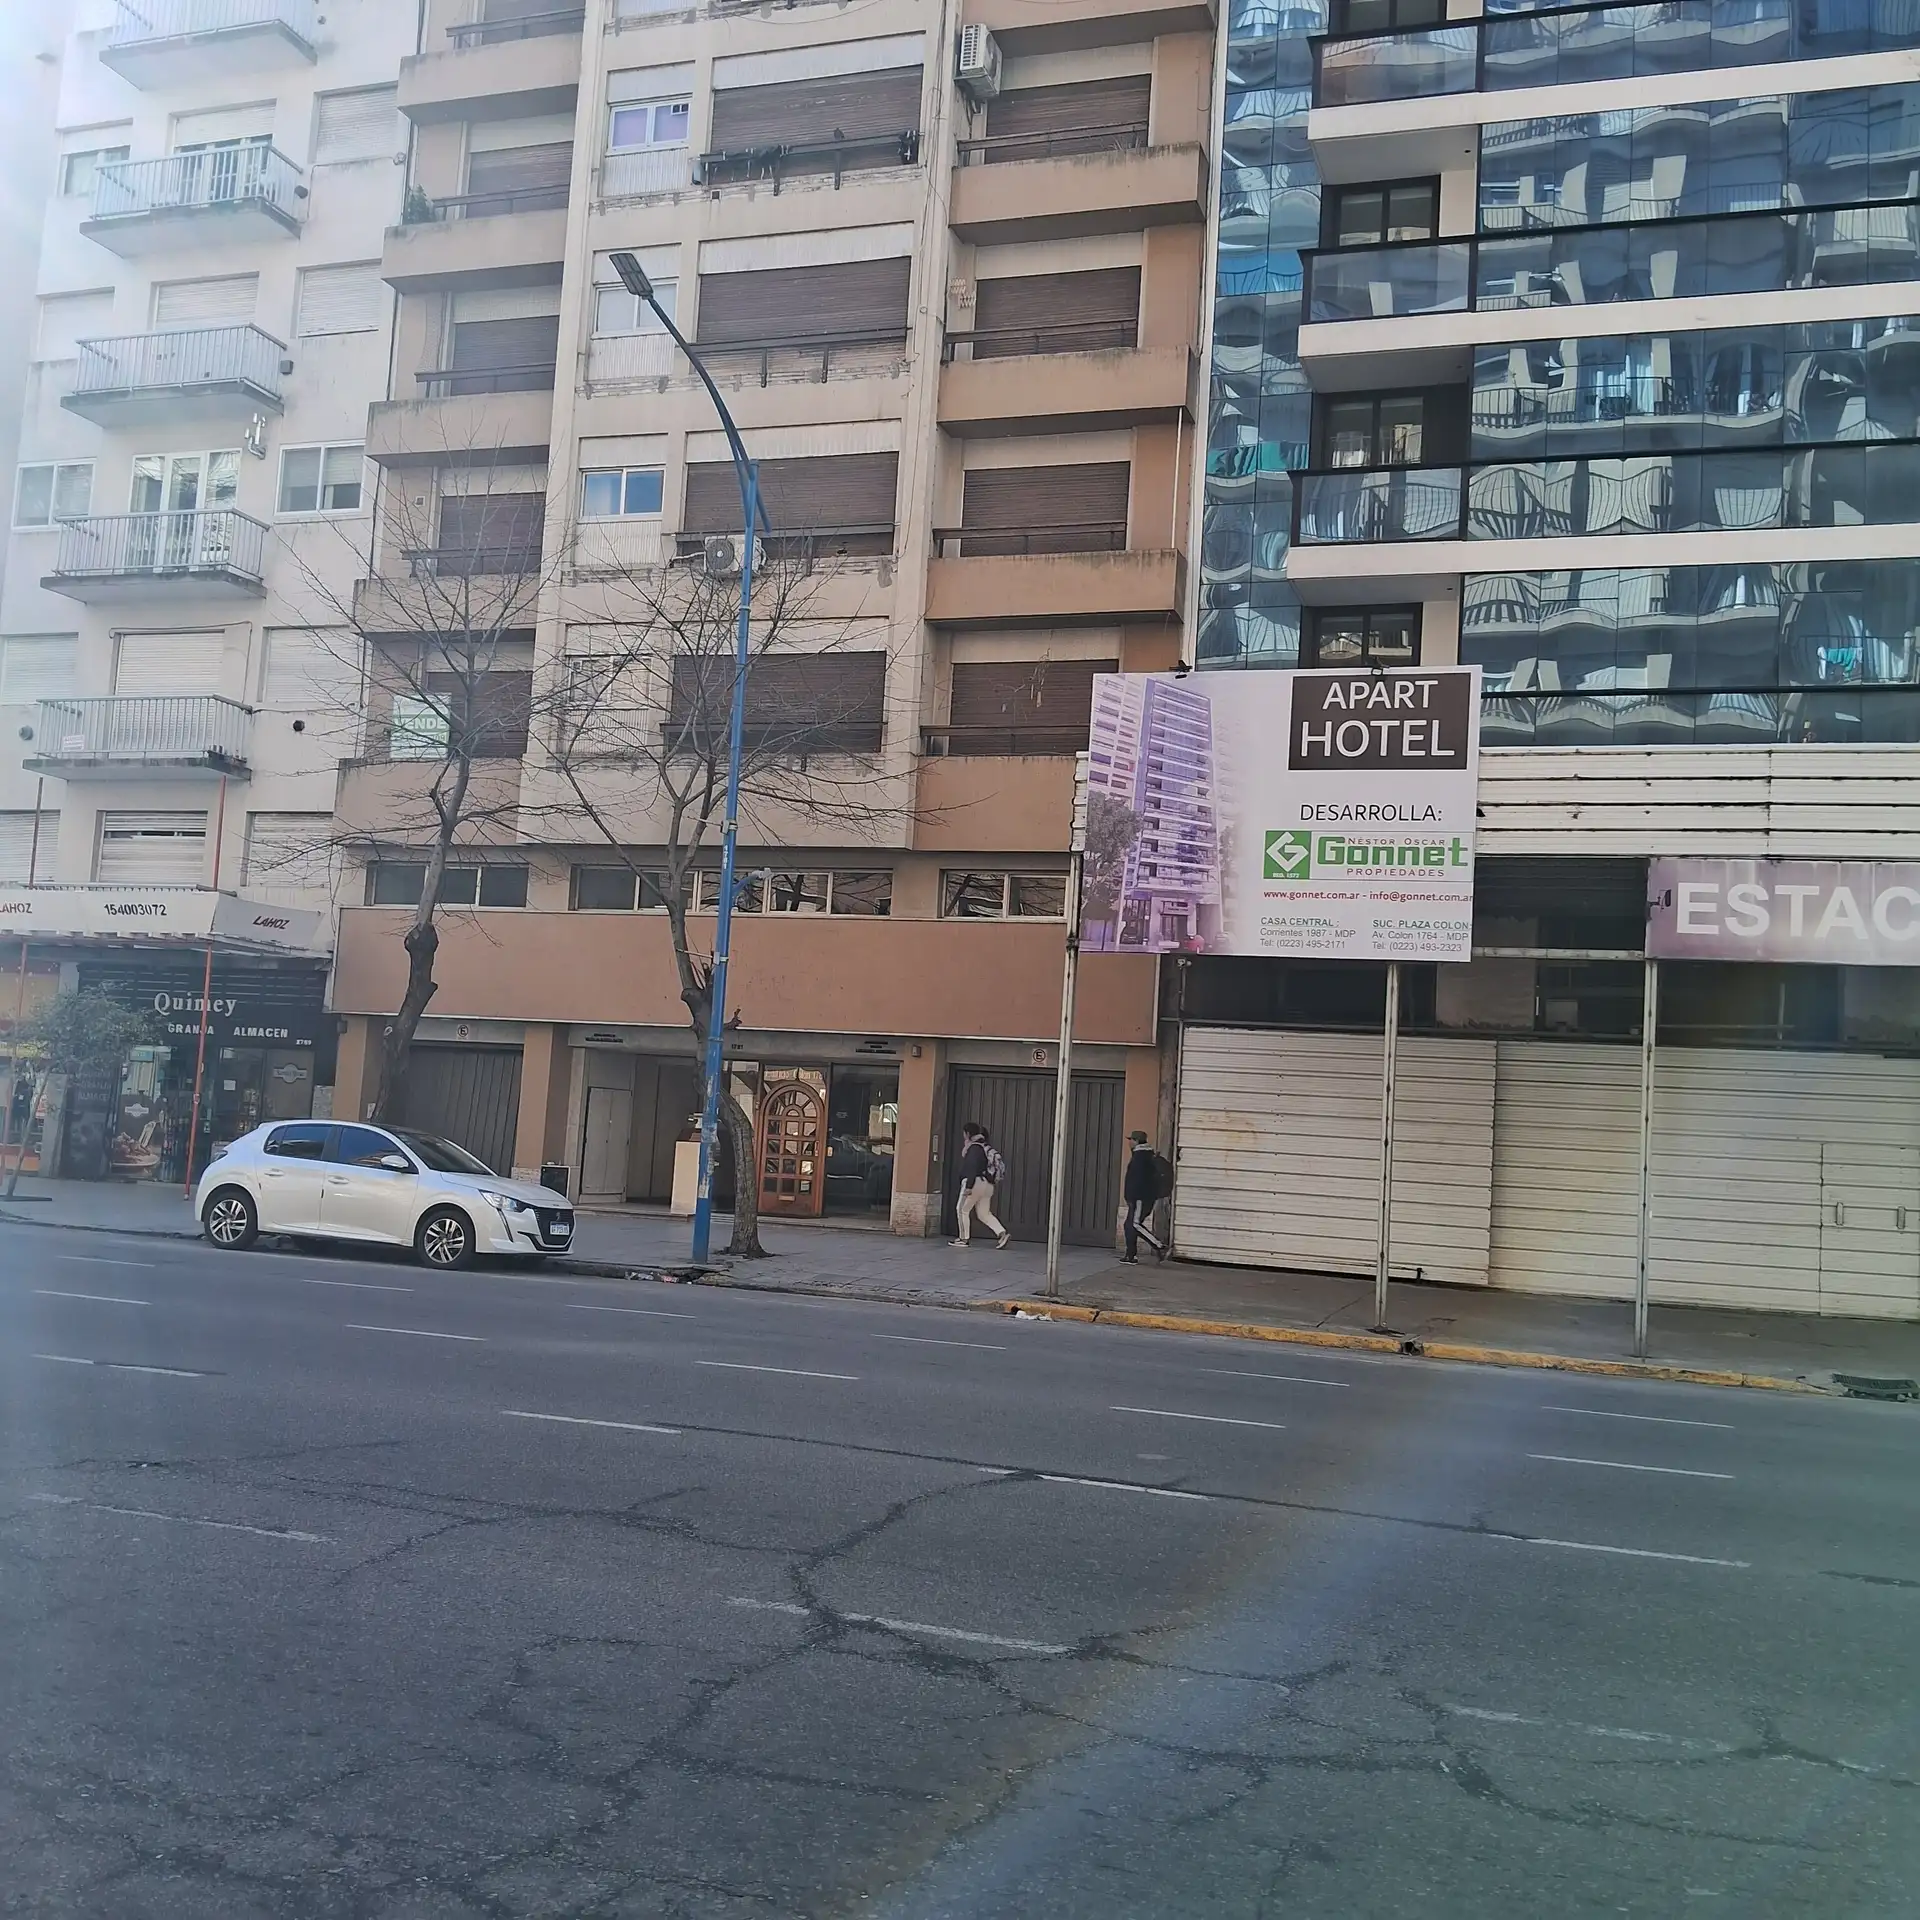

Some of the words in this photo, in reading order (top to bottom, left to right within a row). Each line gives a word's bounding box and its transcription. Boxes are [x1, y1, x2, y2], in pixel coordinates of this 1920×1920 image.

[1322, 680, 1439, 710] APART
[1300, 719, 1456, 758] HOTEL
[1300, 803, 1444, 822] DESARROLLA:
[1404, 837, 1446, 847] OSCAR
[1317, 836, 1469, 867] Gonnet
[1346, 868, 1445, 877] PROPIEDADES
[1263, 890, 1360, 901] www.gonnet.com.ar
[104, 903, 168, 916] 154003072
[1676, 881, 1920, 941] ESTAC
[252, 915, 290, 930] LAHOZ
[1260, 917, 1288, 926] CASA
[1289, 918, 1333, 927] CENTRAL
[1372, 919, 1396, 929] SUC.
[1398, 920, 1431, 930] PLAZA
[1307, 929, 1327, 938] 1987
[1335, 930, 1357, 938] MDP
[1306, 939, 1346, 949] 495-2171
[1419, 942, 1462, 952] 493-2323
[233, 1026, 289, 1038] ALMACEN
